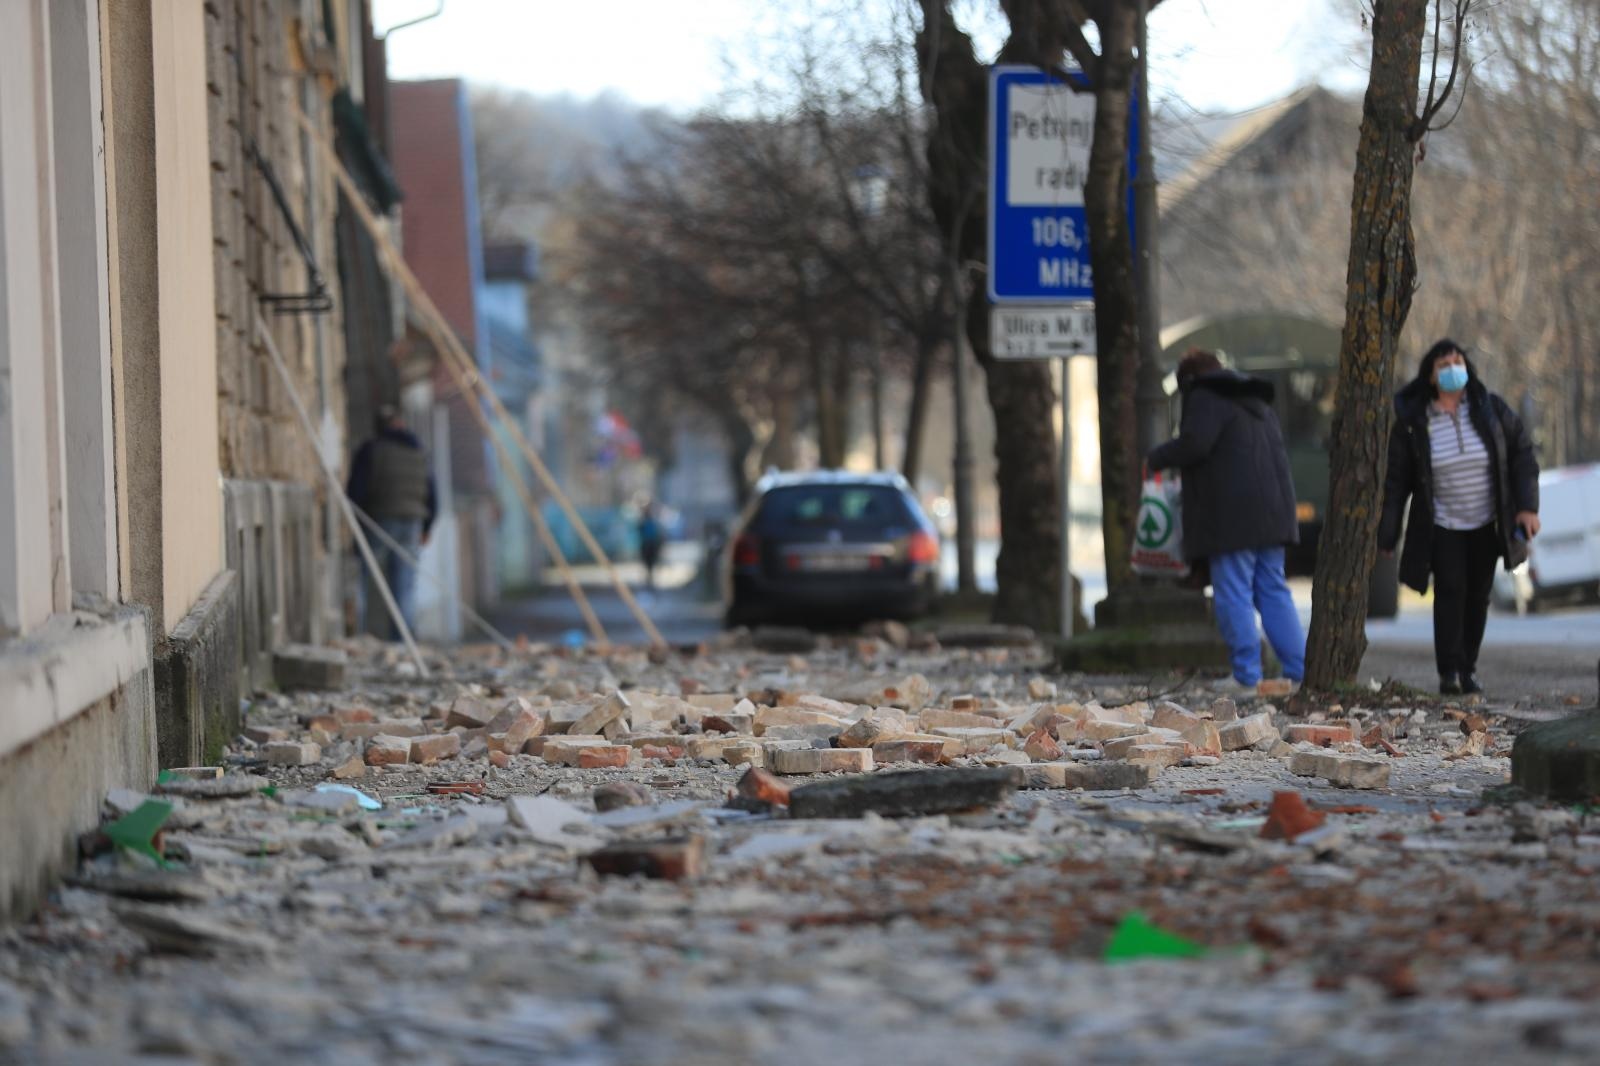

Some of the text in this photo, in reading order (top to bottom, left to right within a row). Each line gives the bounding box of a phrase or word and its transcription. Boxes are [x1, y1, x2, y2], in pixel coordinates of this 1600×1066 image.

[1011, 112, 1090, 149] Petrinj
[1032, 217, 1090, 251] 106,
[1039, 258, 1094, 288] MHz
